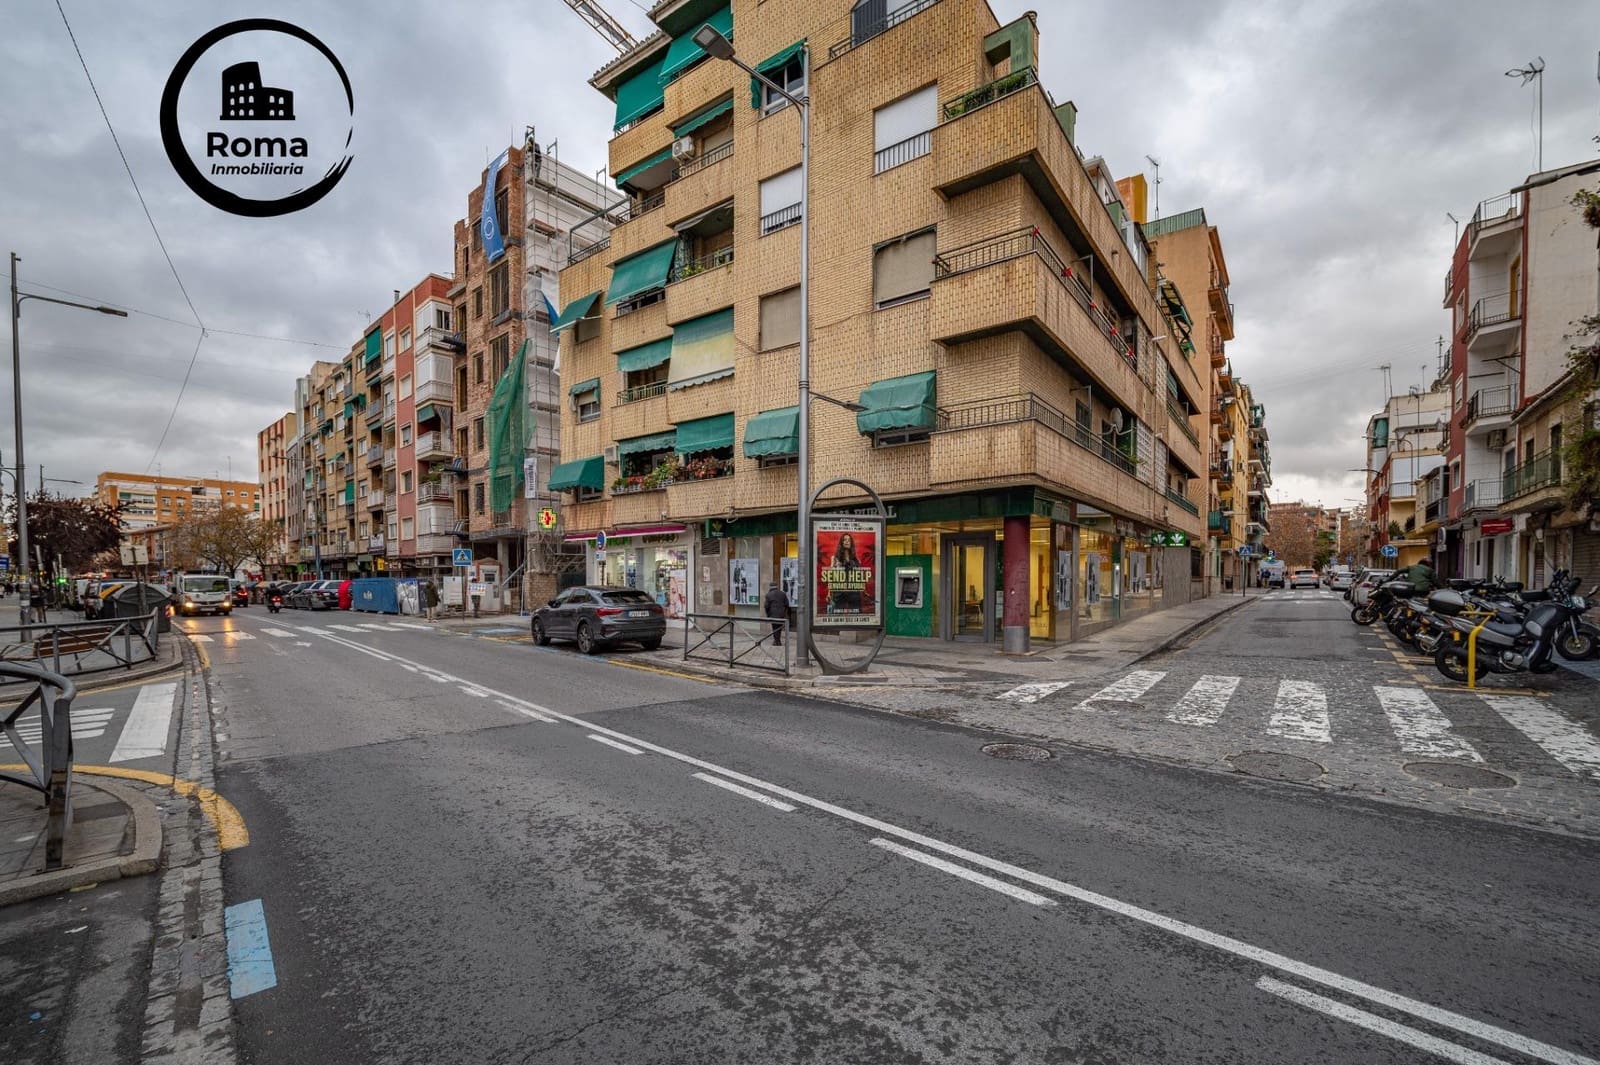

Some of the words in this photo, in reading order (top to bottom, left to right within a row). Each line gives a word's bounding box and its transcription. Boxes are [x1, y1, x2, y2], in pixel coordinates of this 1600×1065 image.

[854, 505, 897, 518] RURL
[821, 570, 846, 583] SEND
[848, 570, 872, 583] HELP
